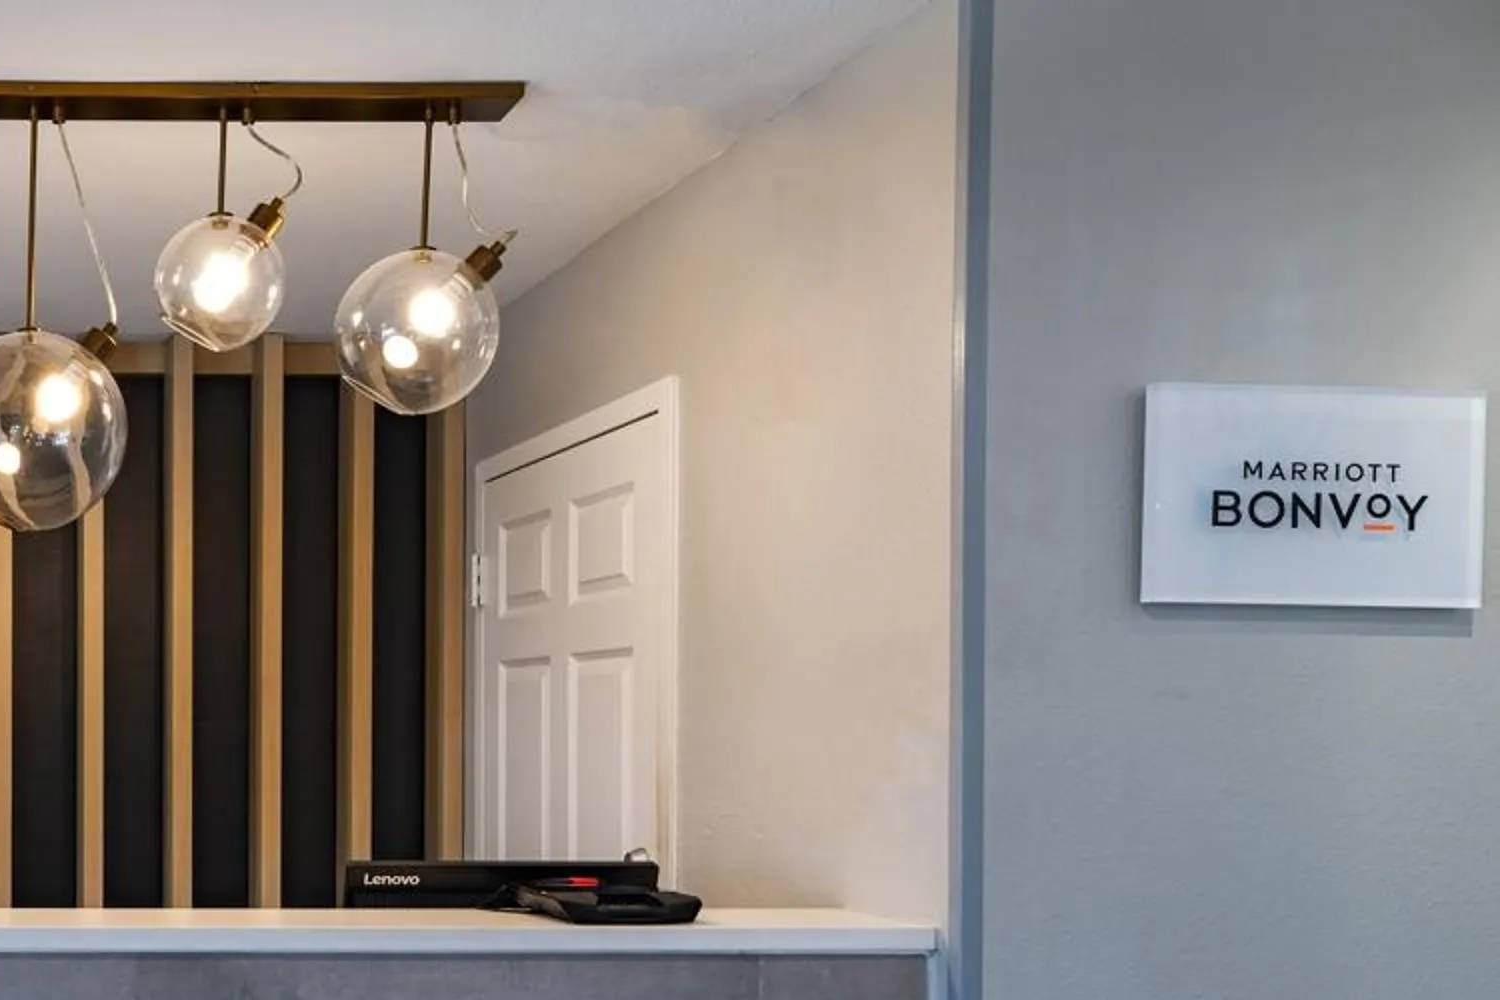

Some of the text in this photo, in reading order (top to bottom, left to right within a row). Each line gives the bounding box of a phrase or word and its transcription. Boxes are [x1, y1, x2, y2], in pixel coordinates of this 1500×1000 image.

[1243, 460, 1400, 483] MARRIOTT
[1211, 489, 1428, 532] BONVOY
[363, 872, 420, 886] Lenovo
